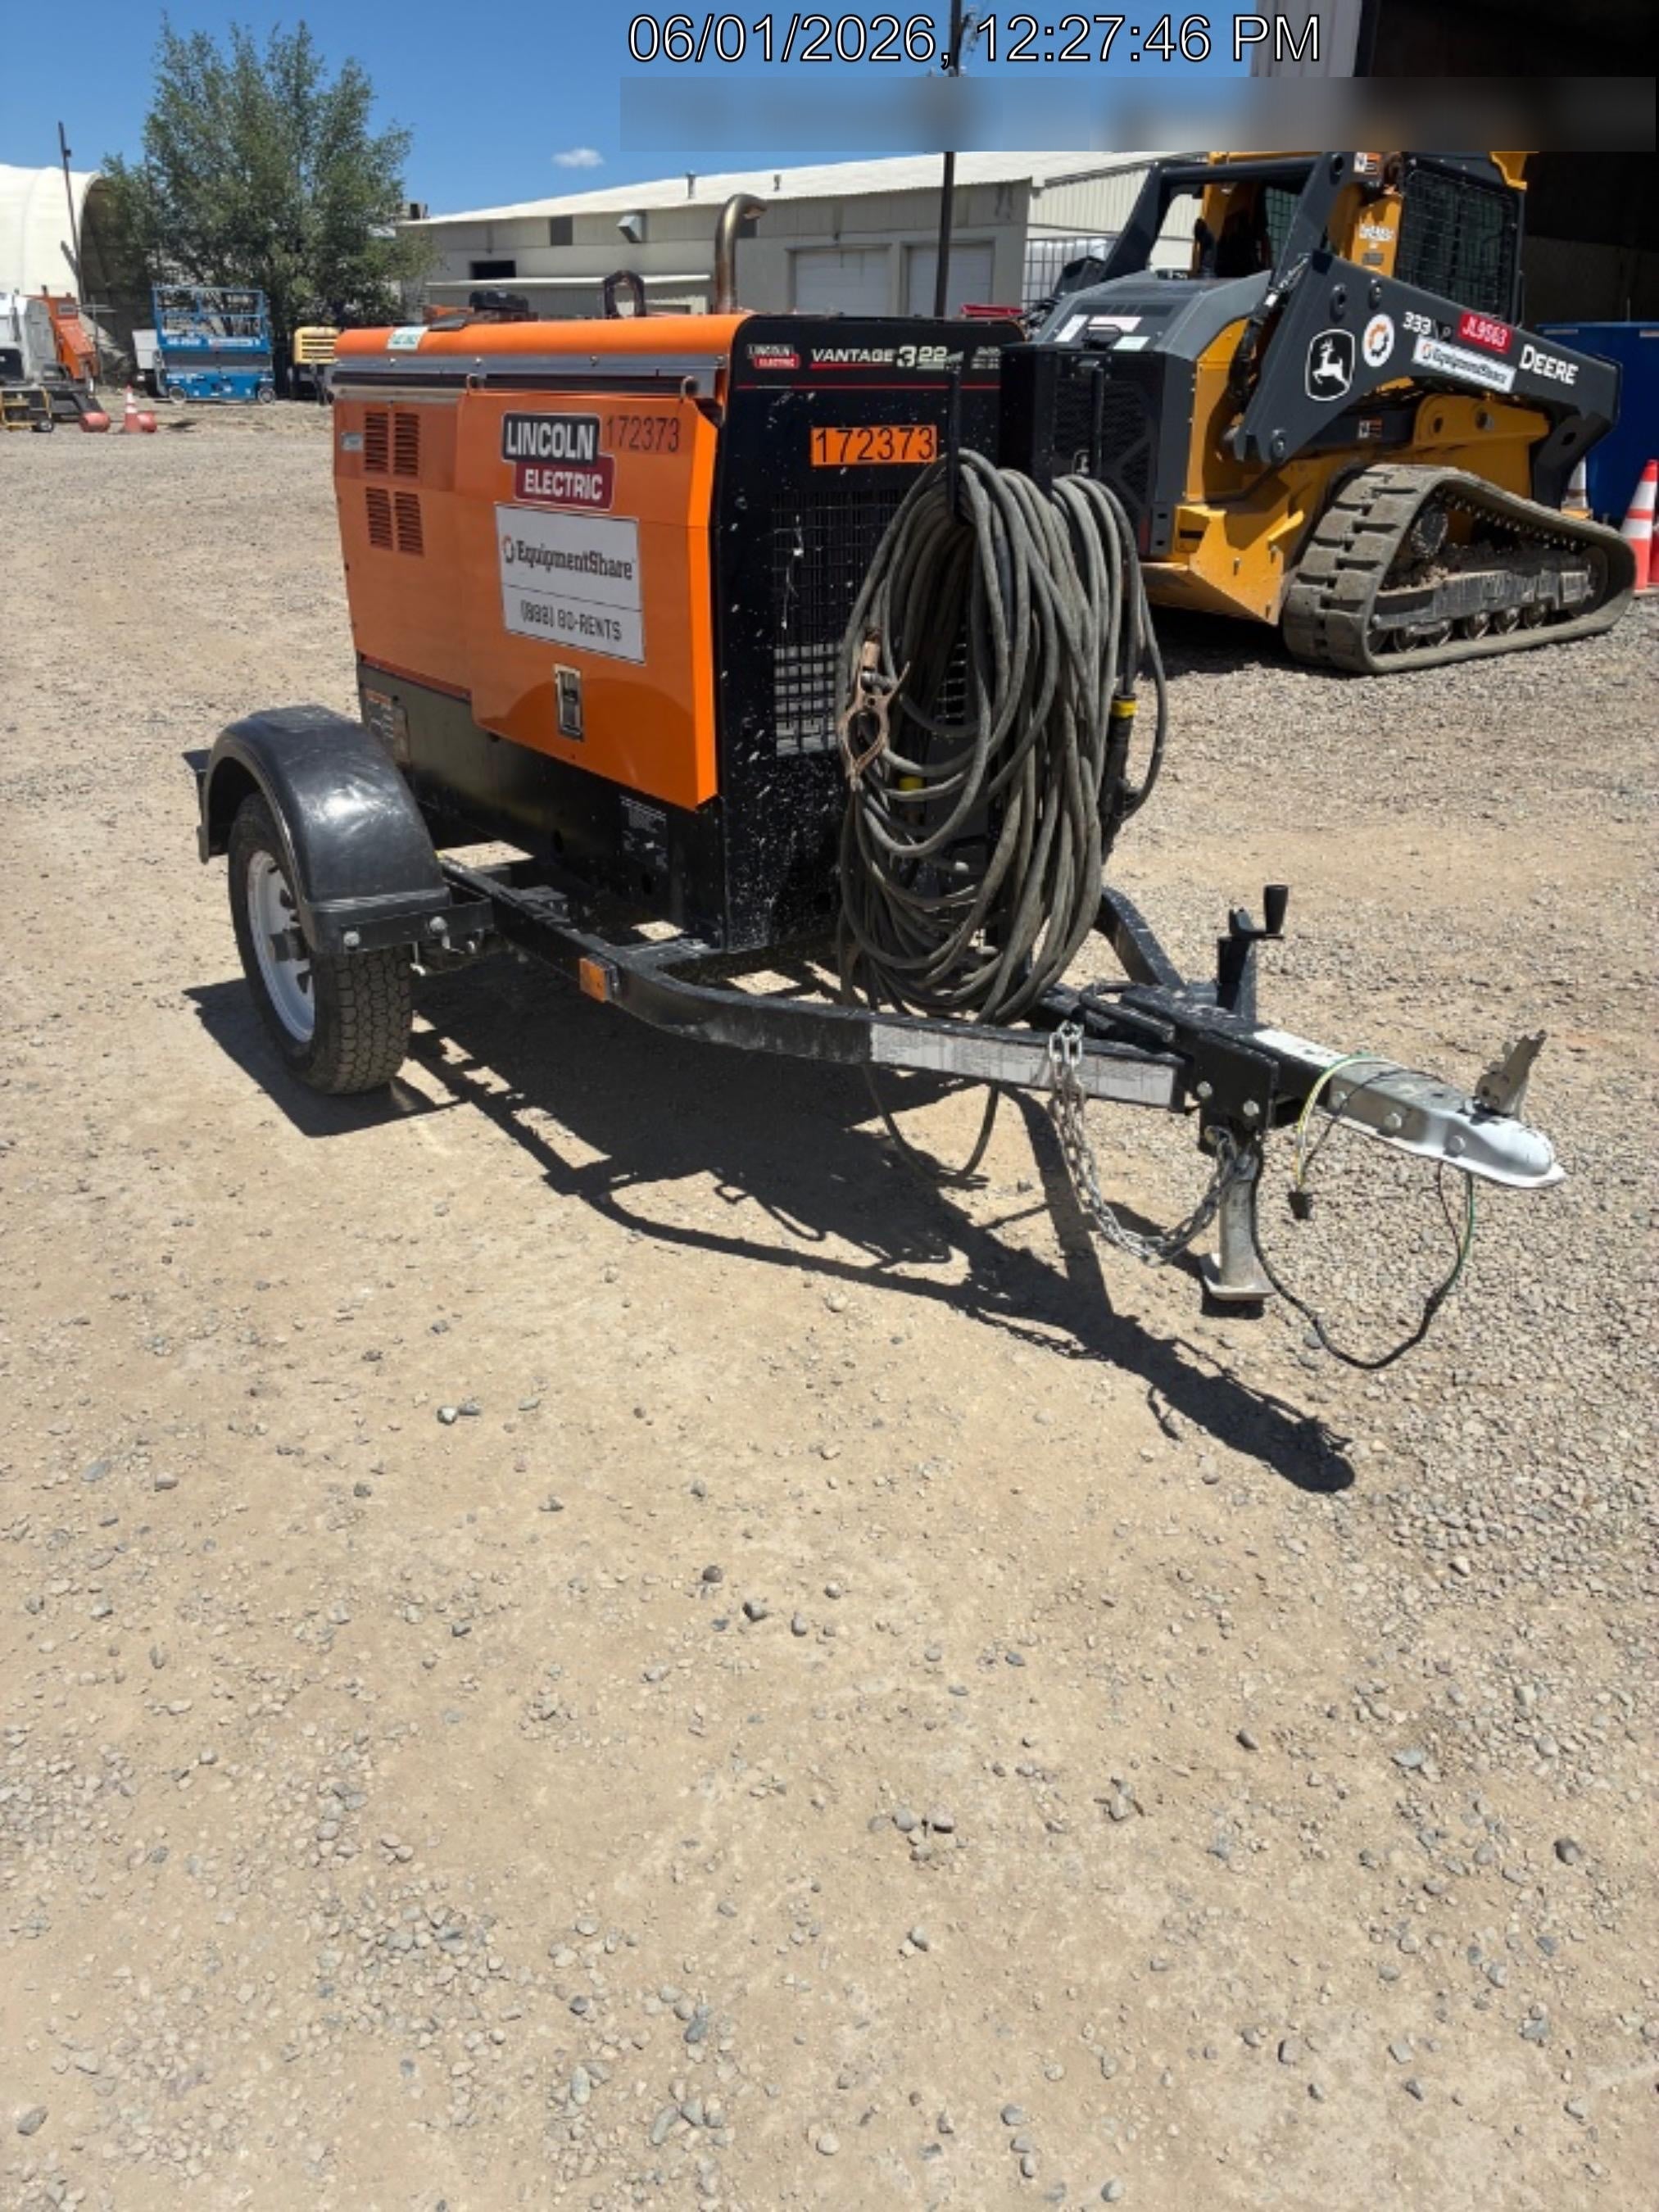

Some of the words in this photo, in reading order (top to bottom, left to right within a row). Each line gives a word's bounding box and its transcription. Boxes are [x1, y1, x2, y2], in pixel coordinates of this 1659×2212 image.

[811, 348, 895, 362] VANTAGE
[896, 346, 948, 367] 322
[1520, 344, 1578, 385] DEERE
[505, 422, 594, 461] LINCOLN
[607, 415, 681, 452] 172373
[815, 427, 935, 463] 172373
[524, 469, 603, 501] ELECTRIC
[516, 541, 633, 581] EquipmentShare
[557, 610, 623, 641] 80-RENTS
